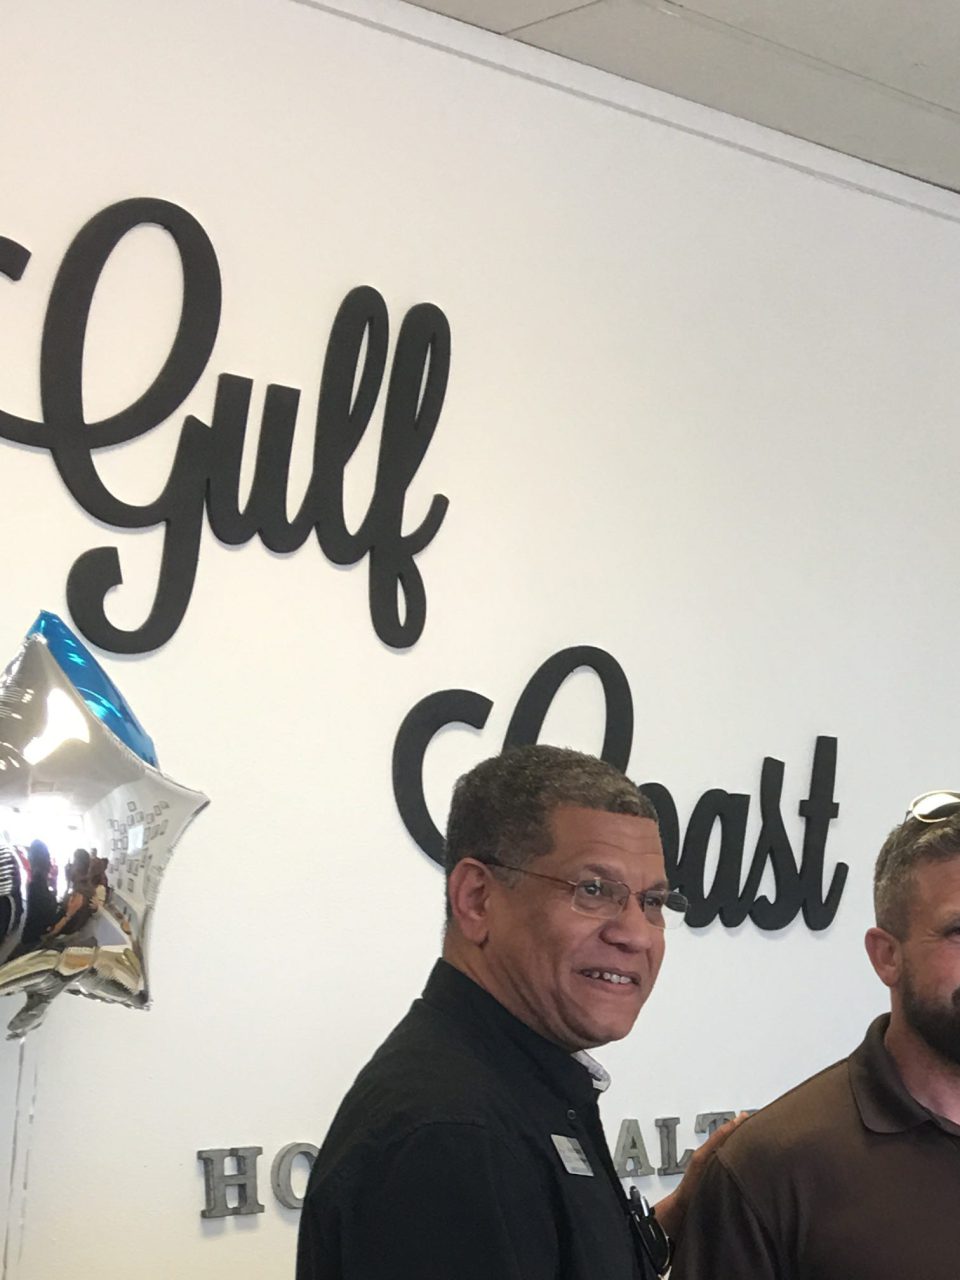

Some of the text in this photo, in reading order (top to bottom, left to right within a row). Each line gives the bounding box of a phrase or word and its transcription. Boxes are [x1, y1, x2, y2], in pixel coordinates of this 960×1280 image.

[0, 197, 450, 654] Gulf
[197, 1109, 758, 1219] HO ALT
